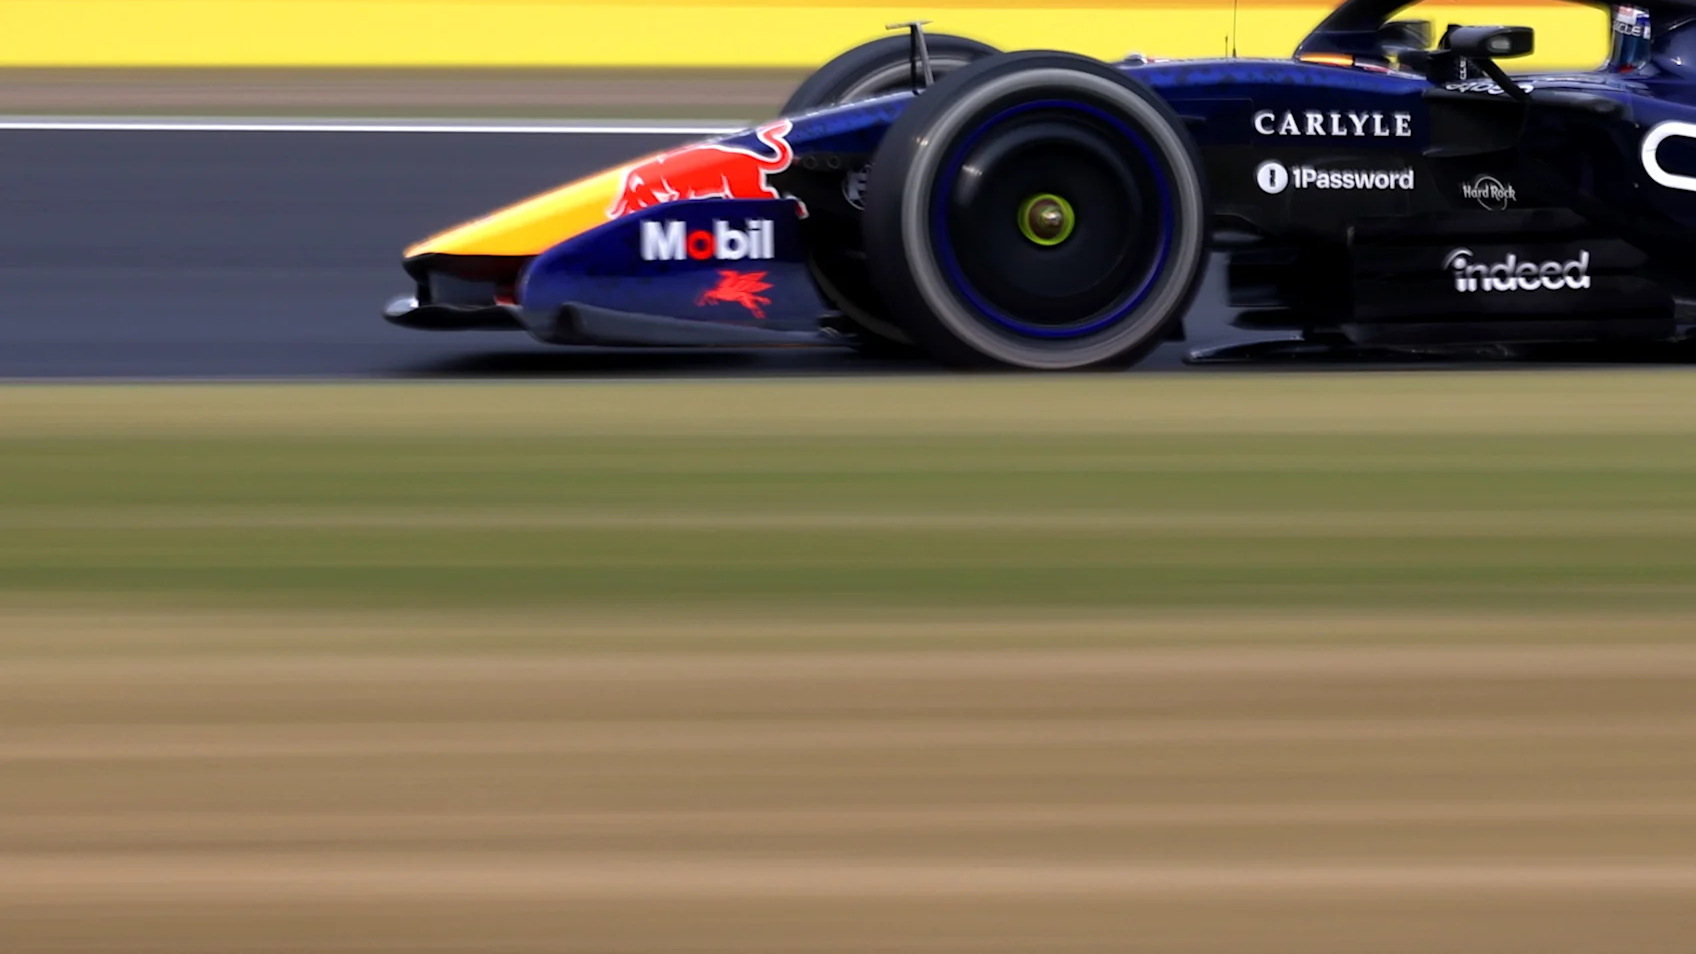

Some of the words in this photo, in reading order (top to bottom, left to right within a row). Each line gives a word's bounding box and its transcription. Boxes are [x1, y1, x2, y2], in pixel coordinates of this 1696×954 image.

[1254, 110, 1412, 137] CARLYLE
[1292, 167, 1415, 190] 1Password
[1462, 183, 1489, 198] Hard
[1490, 183, 1516, 201] Rock
[640, 219, 775, 261] Mobil
[1446, 248, 1591, 292] indeed
